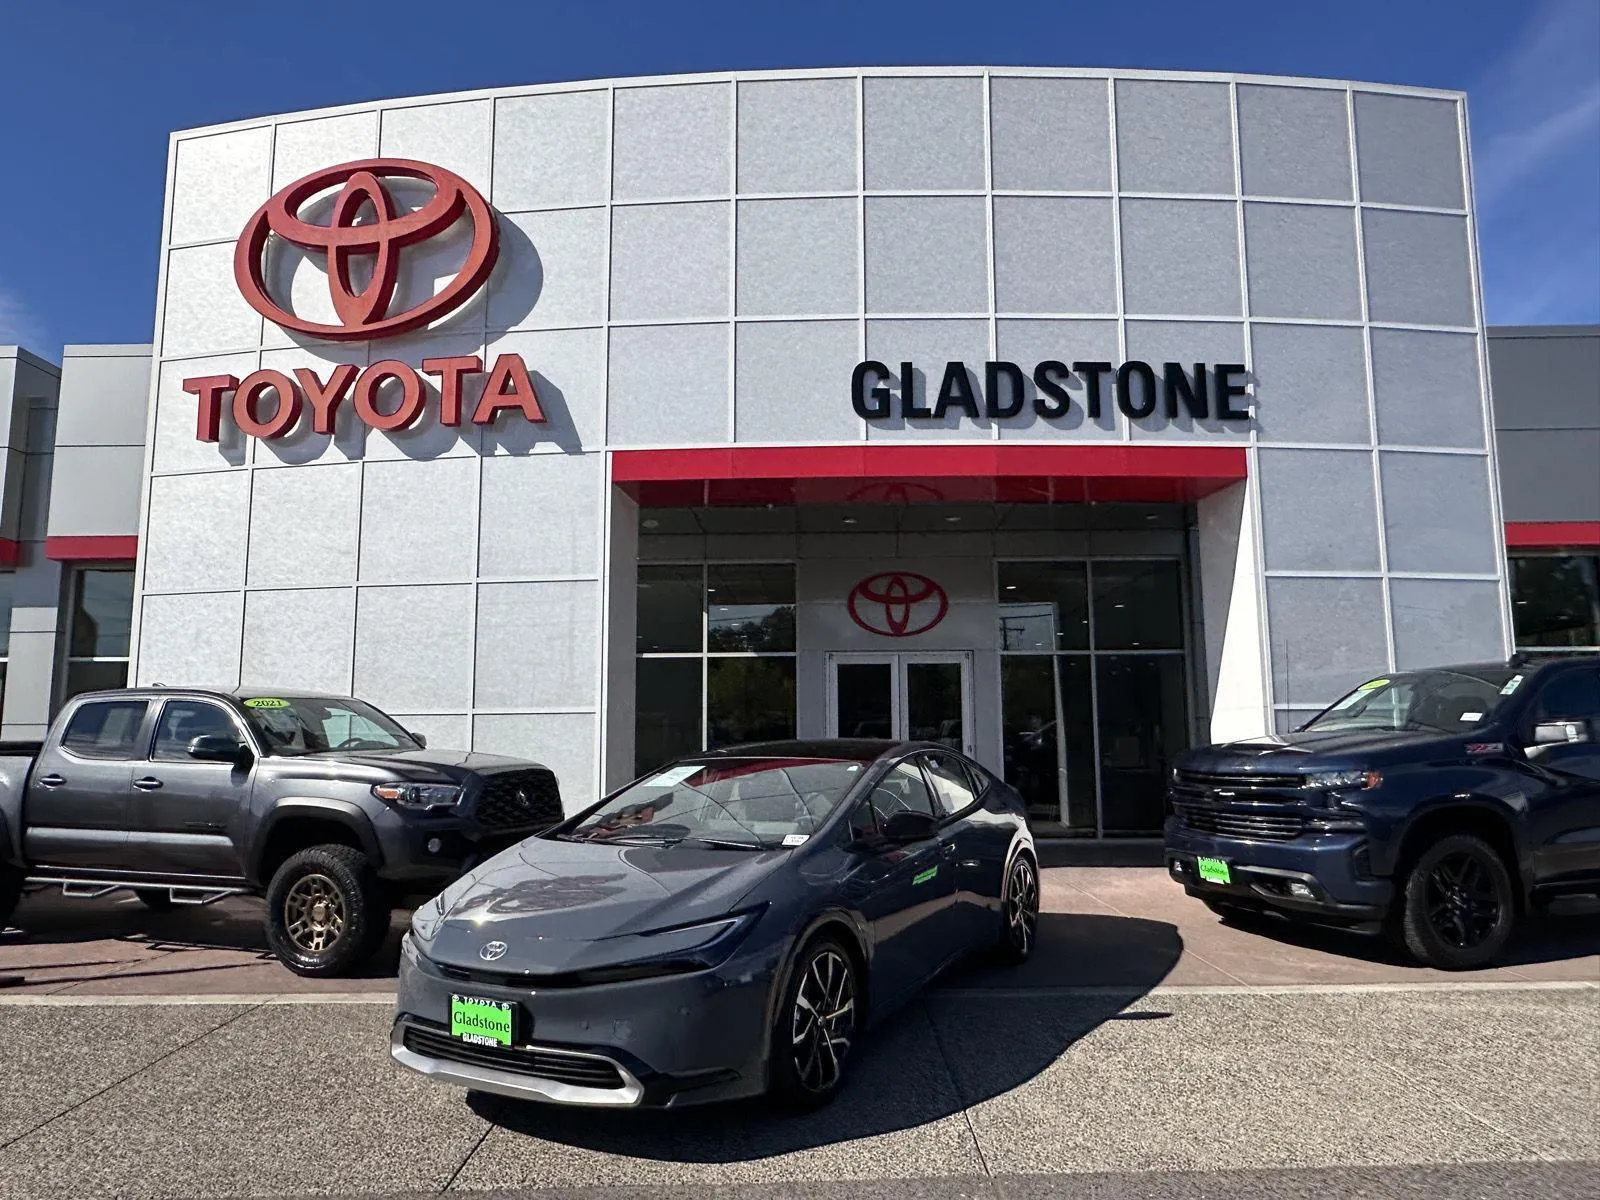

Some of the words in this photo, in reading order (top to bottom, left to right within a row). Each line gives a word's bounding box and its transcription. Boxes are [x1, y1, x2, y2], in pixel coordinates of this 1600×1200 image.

[182, 353, 547, 443] TOYOTA
[851, 360, 1250, 421] GLADSTONE
[463, 996, 497, 1008] TOYOTA
[453, 1011, 510, 1033] Gladstone
[462, 1033, 497, 1047] GLADSTONE
